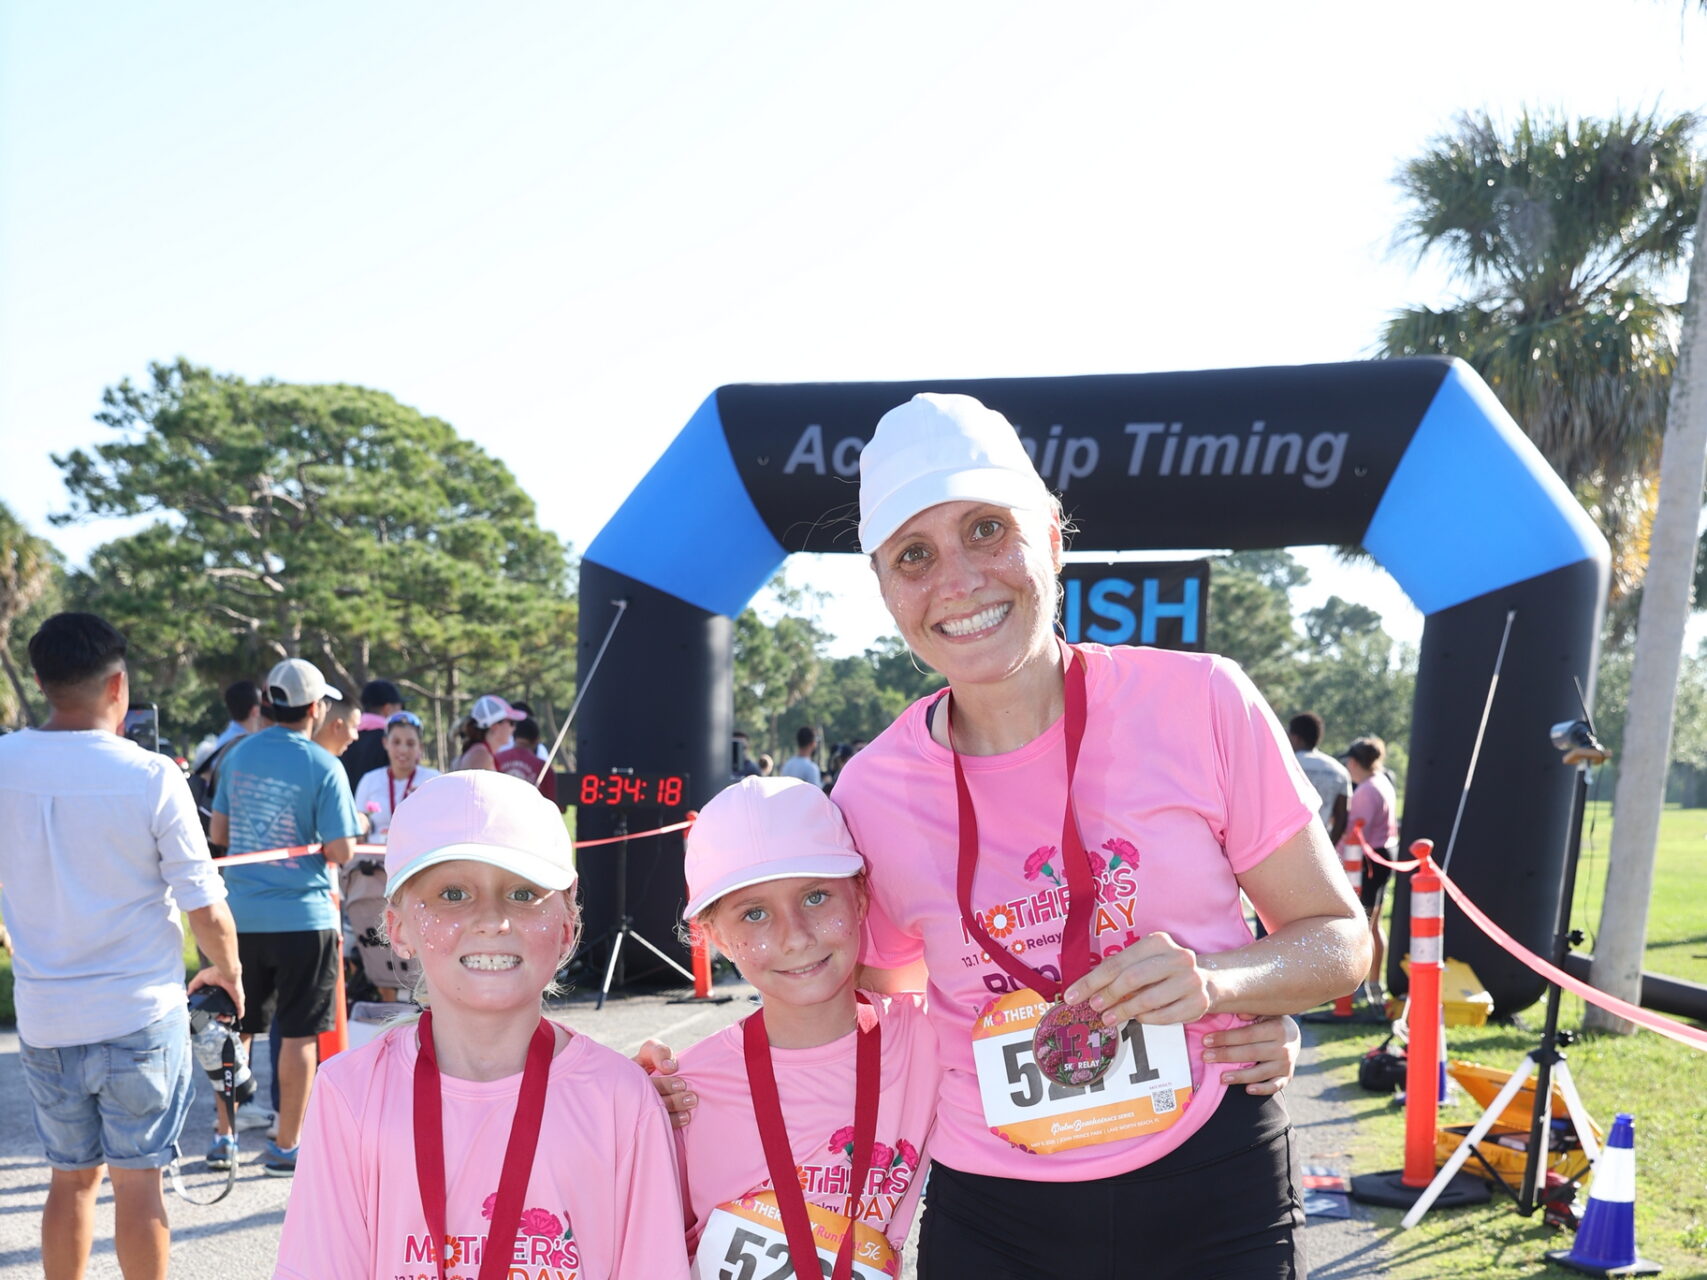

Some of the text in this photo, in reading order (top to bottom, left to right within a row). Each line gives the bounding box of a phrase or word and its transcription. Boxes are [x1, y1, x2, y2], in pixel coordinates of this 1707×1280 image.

[1123, 420, 1349, 489] Timing
[1061, 577, 1200, 644] ISH
[580, 774, 683, 806] 8:34:18
[1094, 897, 1137, 938] AY
[1026, 932, 1062, 950] Relay
[1002, 1019, 1160, 1108] 51
[1078, 1060, 1100, 1069] RELAY
[405, 1234, 580, 1270] MOTER'S
